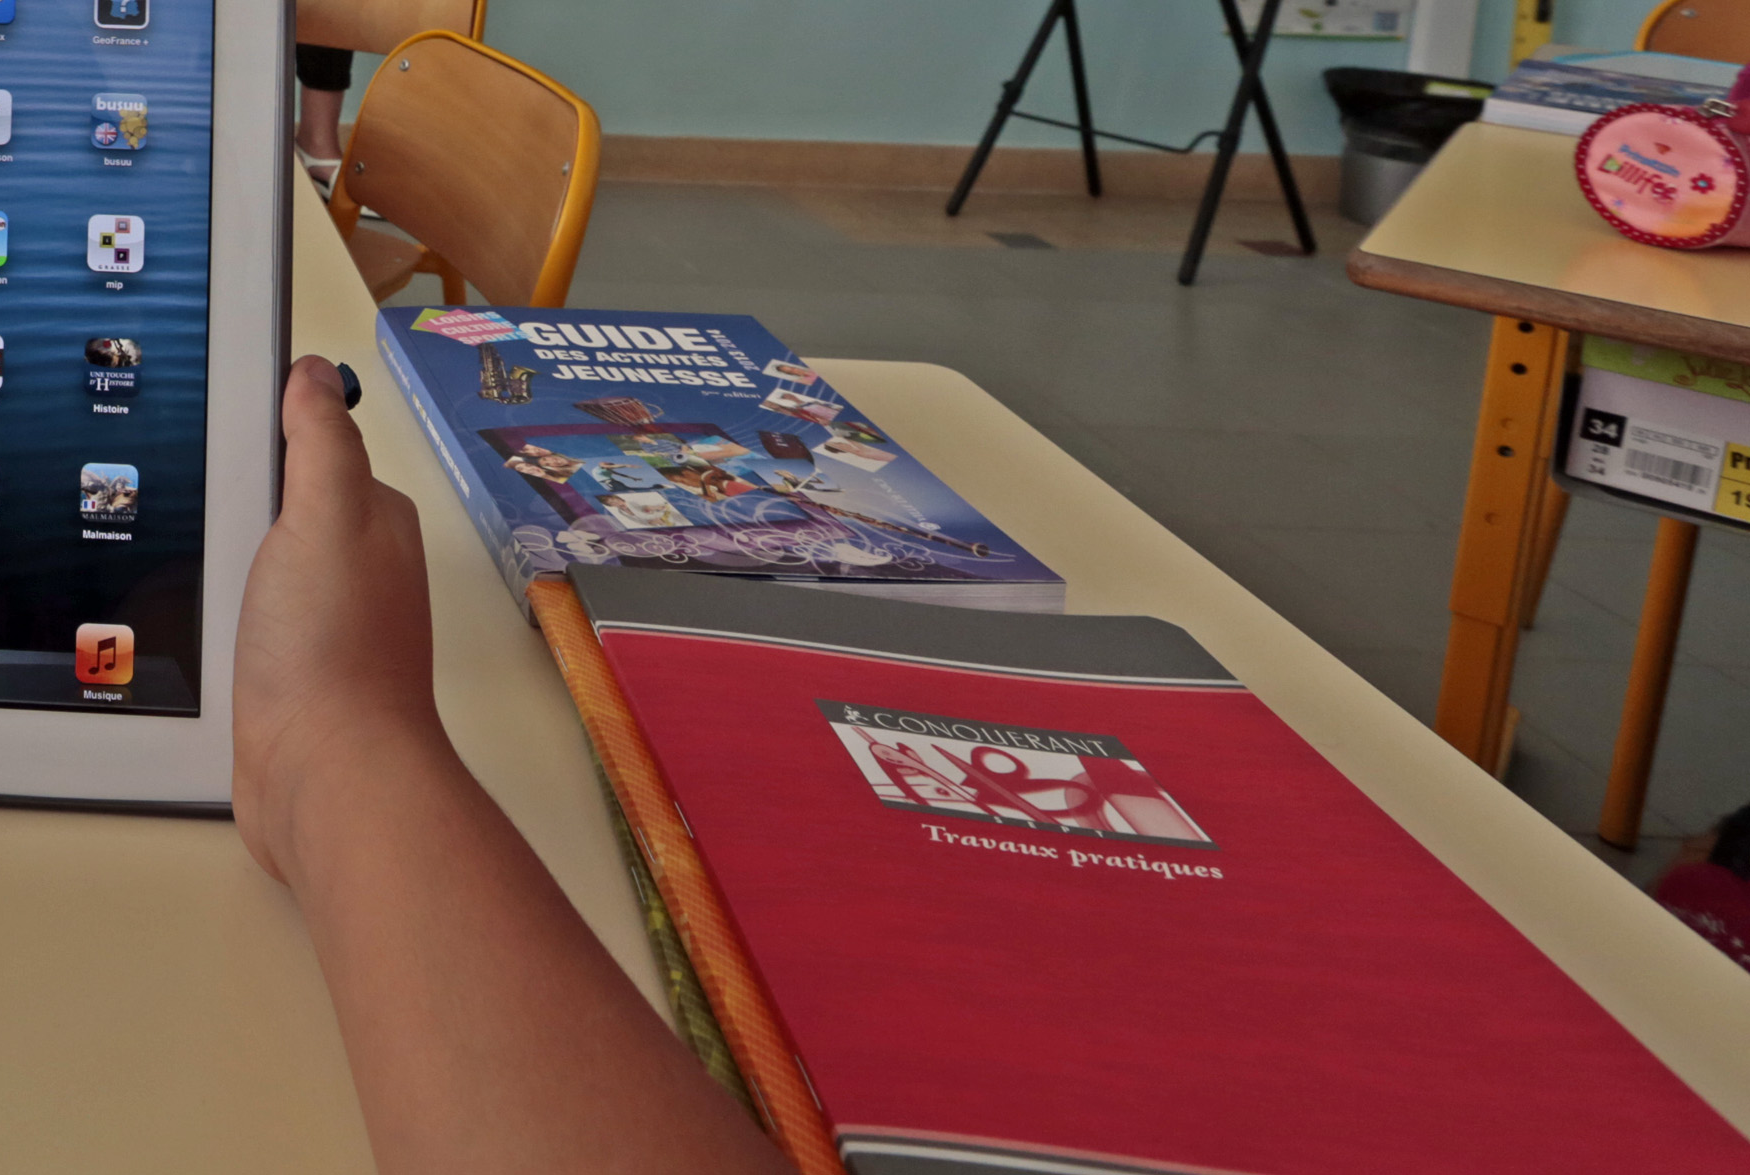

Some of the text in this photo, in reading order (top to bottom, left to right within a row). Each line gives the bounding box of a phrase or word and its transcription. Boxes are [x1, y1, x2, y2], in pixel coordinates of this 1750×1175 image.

[92, 35, 140, 46] GeoFrance
[96, 96, 144, 112] busuu
[104, 157, 132, 167] busuu
[106, 280, 124, 290] mip
[429, 312, 498, 326] LOISIRS
[441, 321, 518, 336] CULTURE
[517, 321, 719, 353] GUIDE
[534, 348, 729, 368] DES ACTIVITÉS
[106, 372, 135, 380] TOUCHE
[552, 364, 757, 388] JEUNESSE
[93, 404, 129, 414] Histoire
[1587, 417, 1619, 439] 34
[82, 513, 135, 521] MALMAISON
[83, 530, 132, 541] Malmaison
[83, 690, 122, 701] Musique
[874, 711, 1110, 758] CONQUERANT
[921, 822, 1224, 881] Travaux pratiques
